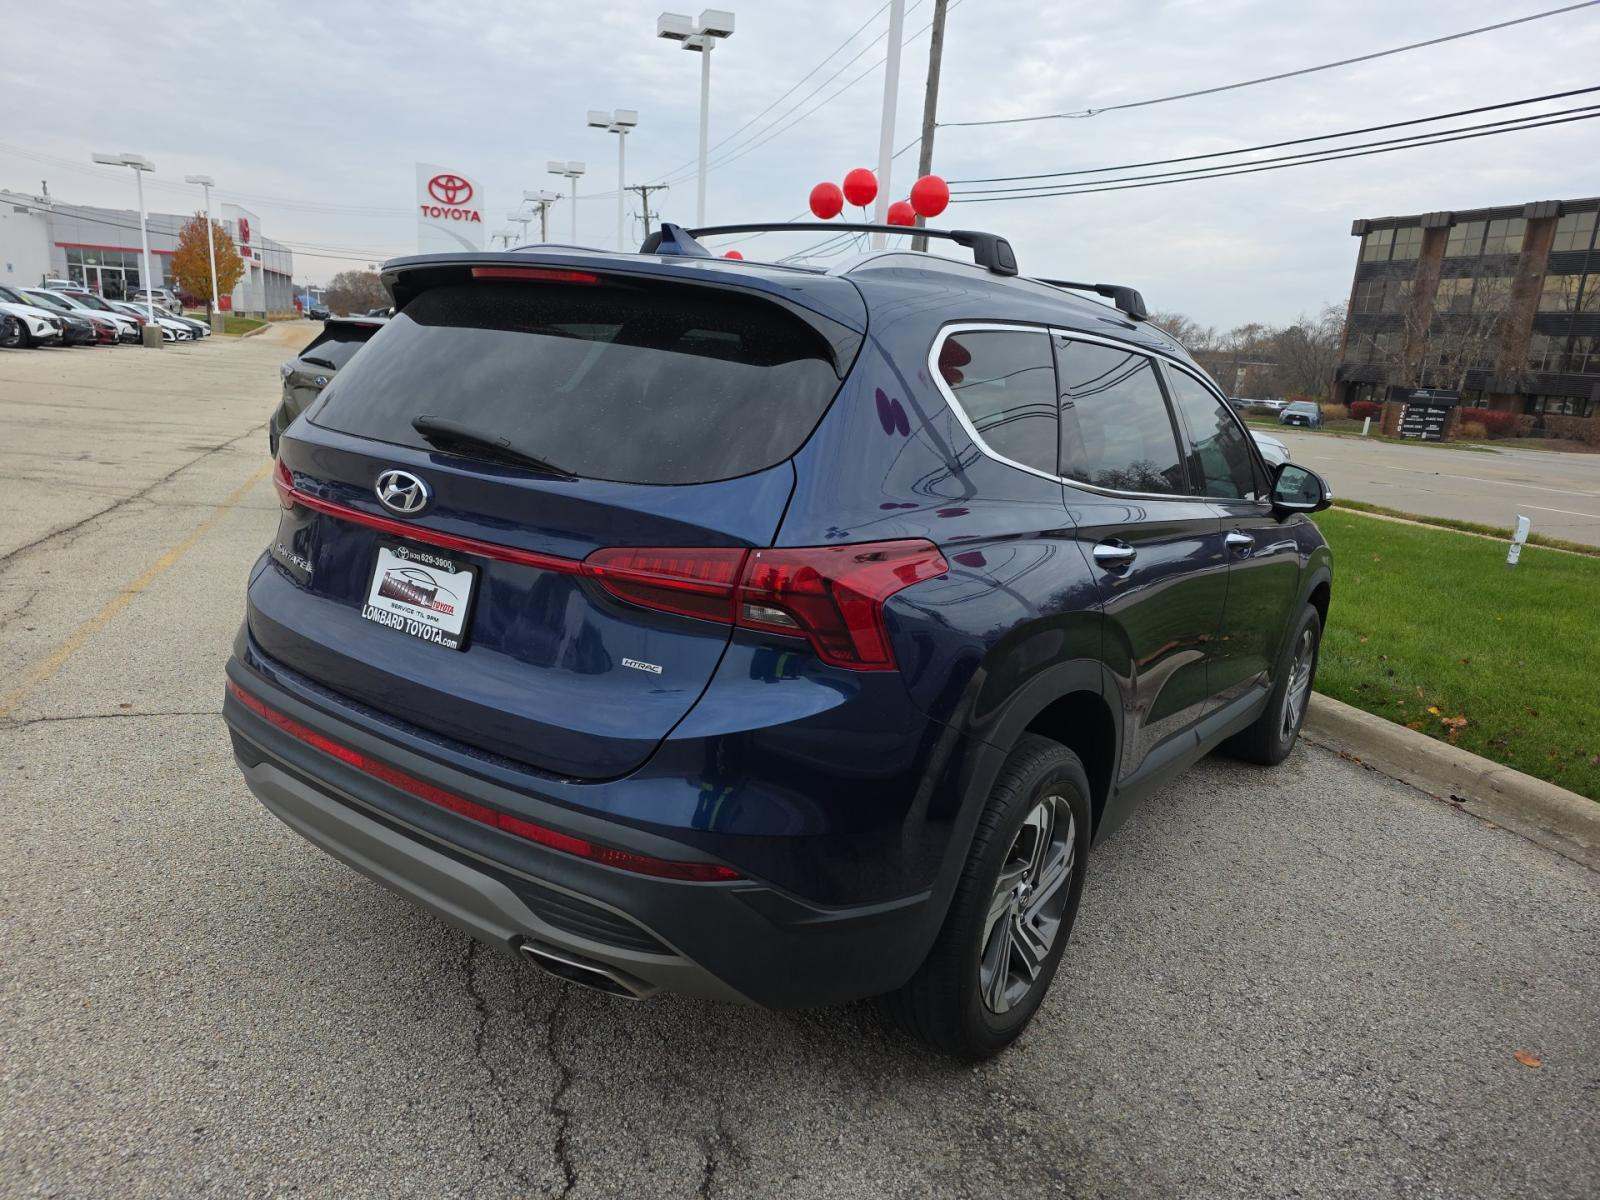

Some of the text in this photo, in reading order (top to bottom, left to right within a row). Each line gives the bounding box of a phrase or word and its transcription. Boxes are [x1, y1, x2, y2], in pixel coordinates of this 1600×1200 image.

[420, 205, 481, 223] TOYOTA
[421, 553, 452, 569] 629-3900
[433, 600, 455, 614] TOYOTA
[361, 604, 458, 650] LOMBARD TOYOTA.com
[623, 659, 661, 674] HTRAC
